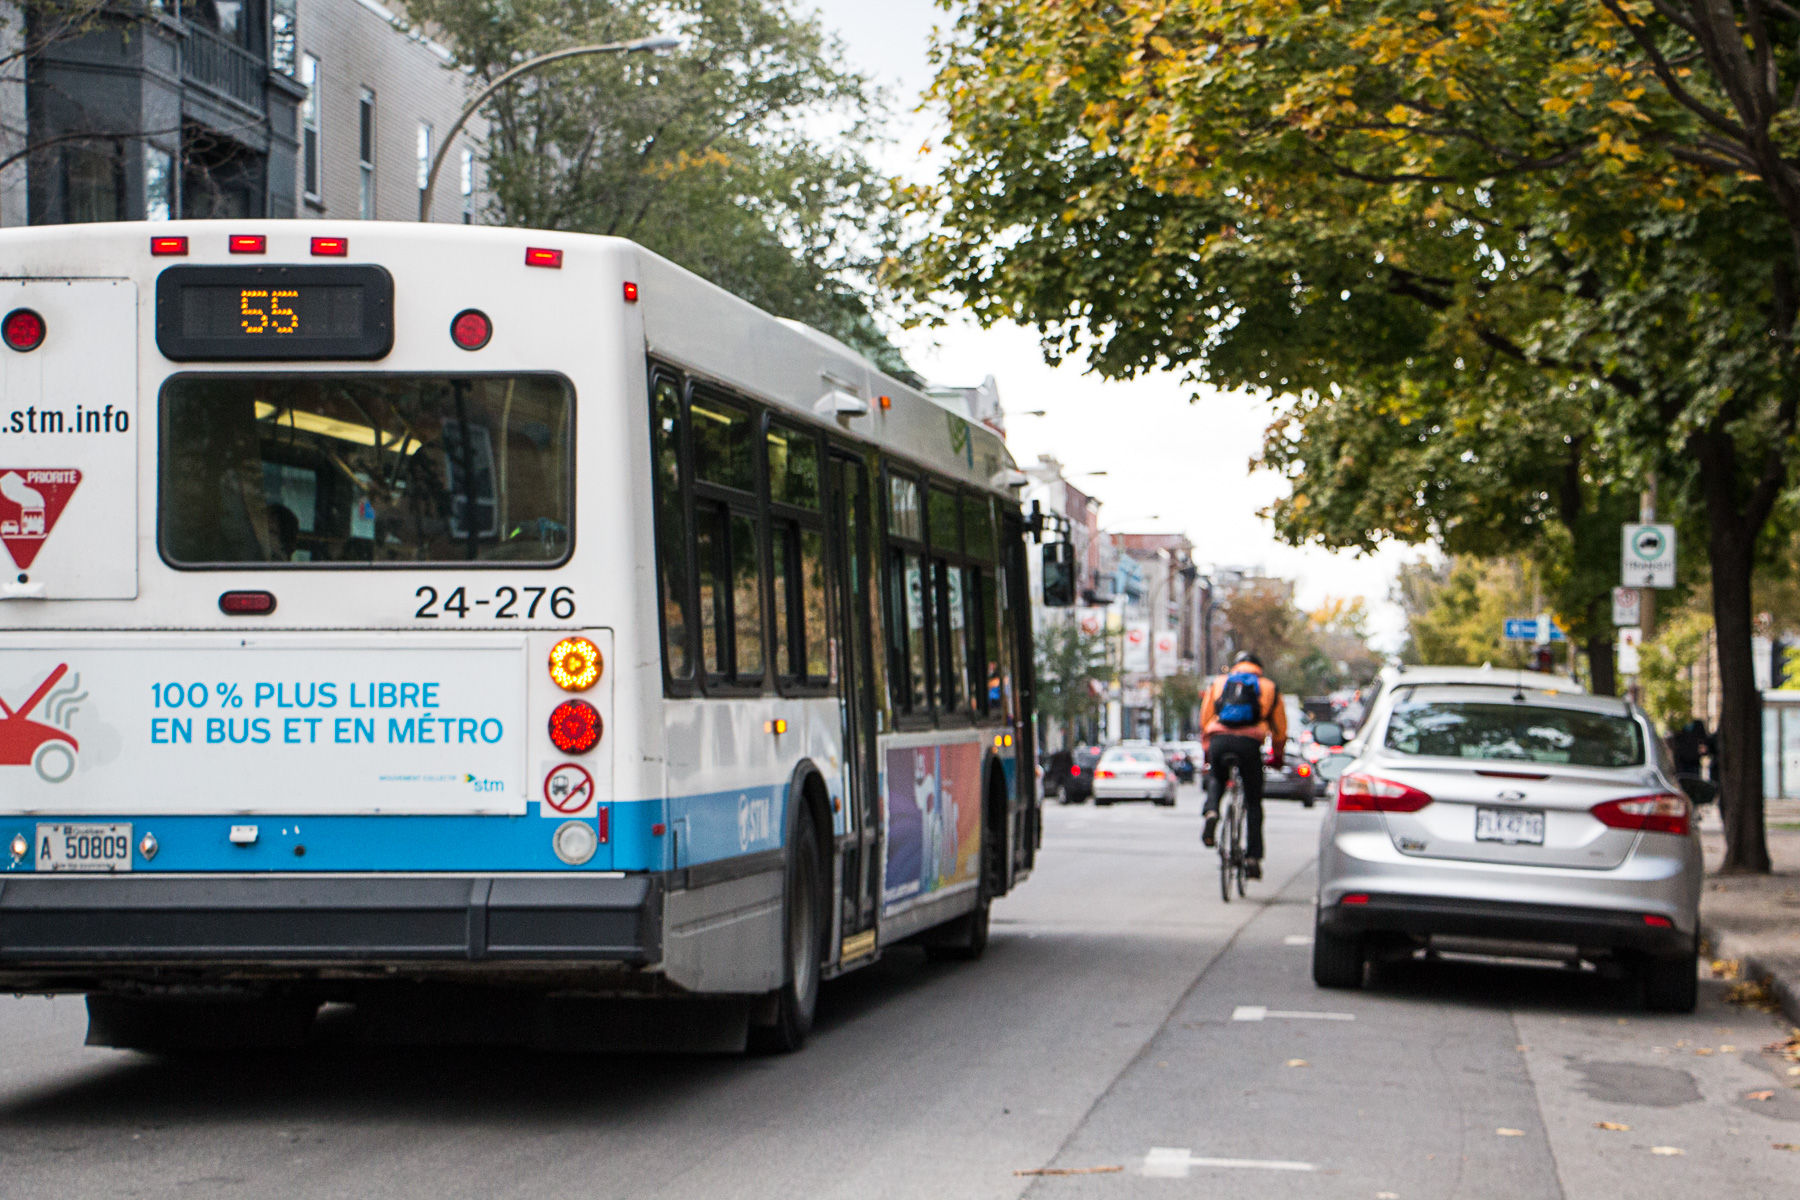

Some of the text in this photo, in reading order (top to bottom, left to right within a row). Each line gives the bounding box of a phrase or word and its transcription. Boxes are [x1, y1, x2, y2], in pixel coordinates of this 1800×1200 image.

[241, 290, 299, 333] 55
[2, 404, 129, 433] .stm.info
[27, 469, 77, 484] PRIORITÉ
[415, 585, 576, 619] 24-276
[151, 681, 440, 708] 100 % PLUS LIBRE
[151, 711, 504, 744] EN BUS ET EN MÉTRO
[473, 778, 505, 792] stm
[40, 835, 128, 860] A 50809
